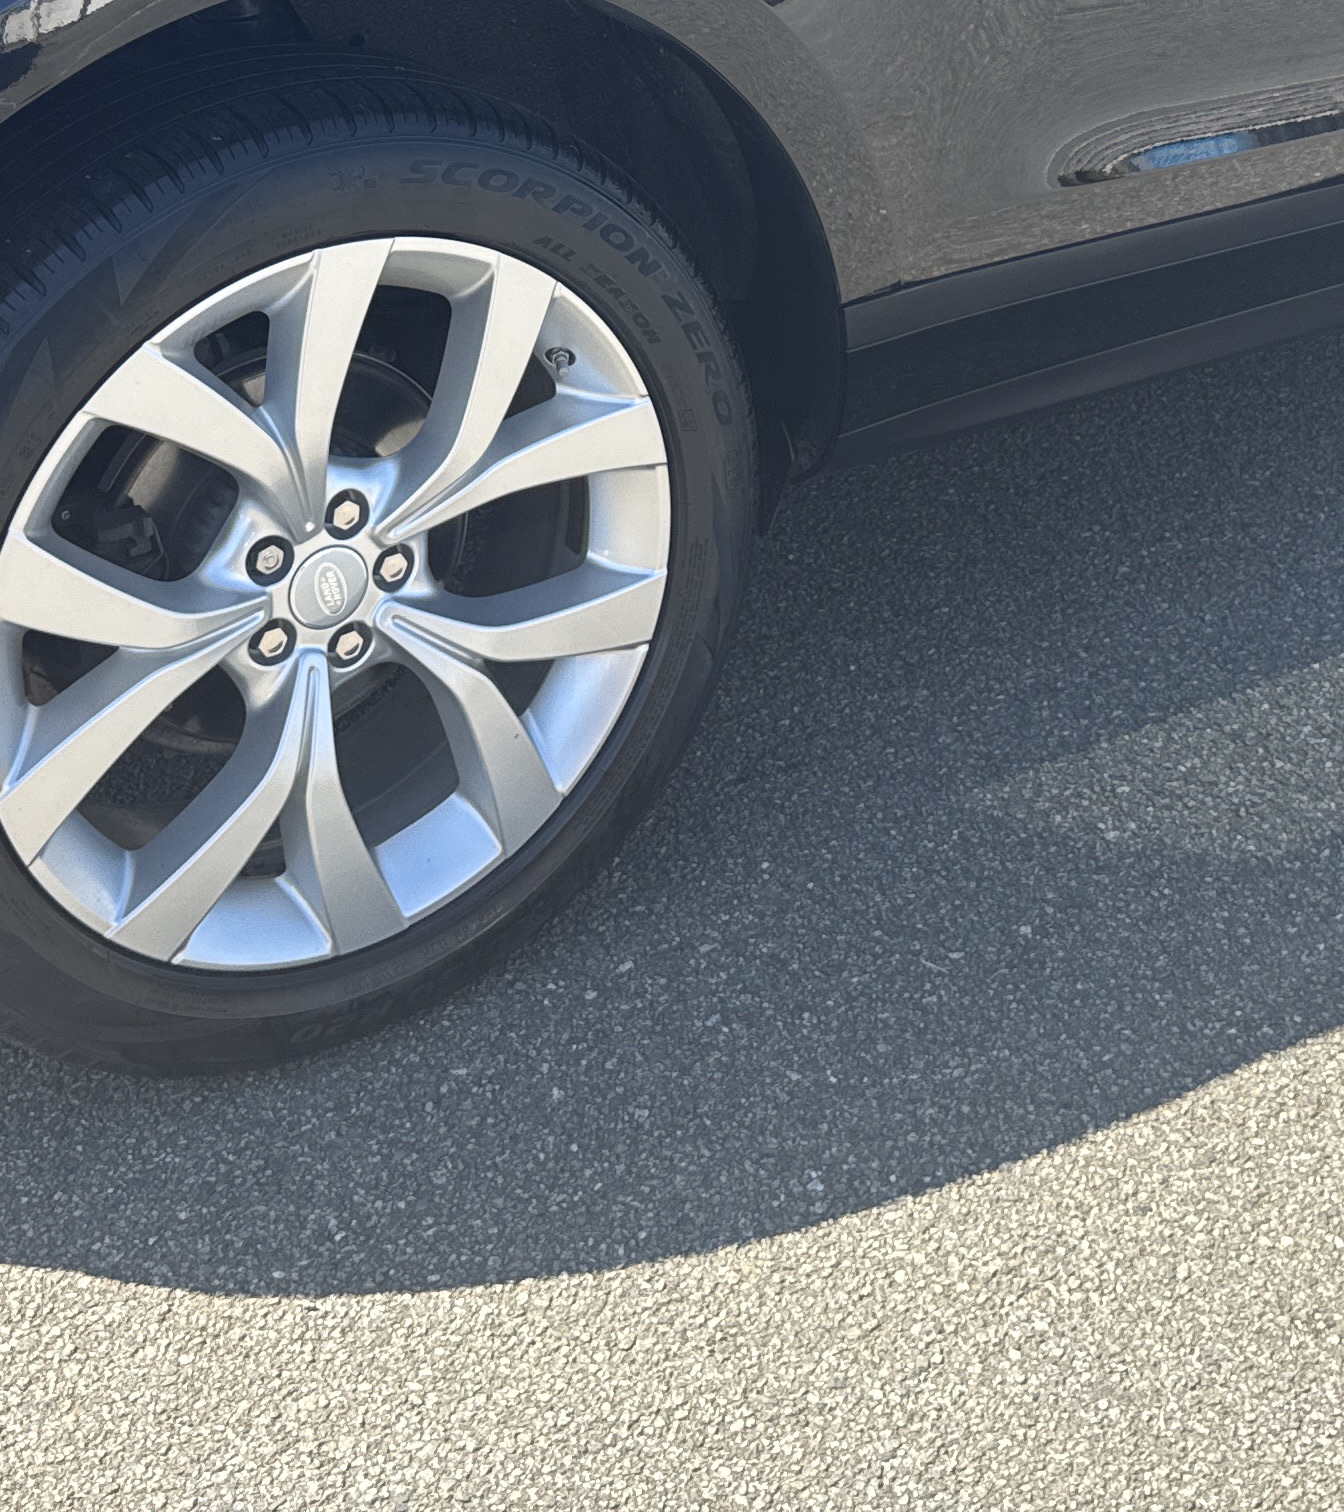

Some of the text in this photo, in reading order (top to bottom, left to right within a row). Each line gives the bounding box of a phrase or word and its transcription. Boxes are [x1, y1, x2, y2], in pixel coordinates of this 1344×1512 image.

[400, 159, 663, 277] SCORPION
[661, 291, 733, 426] ZERO
[532, 236, 663, 346] ALL SEASON
